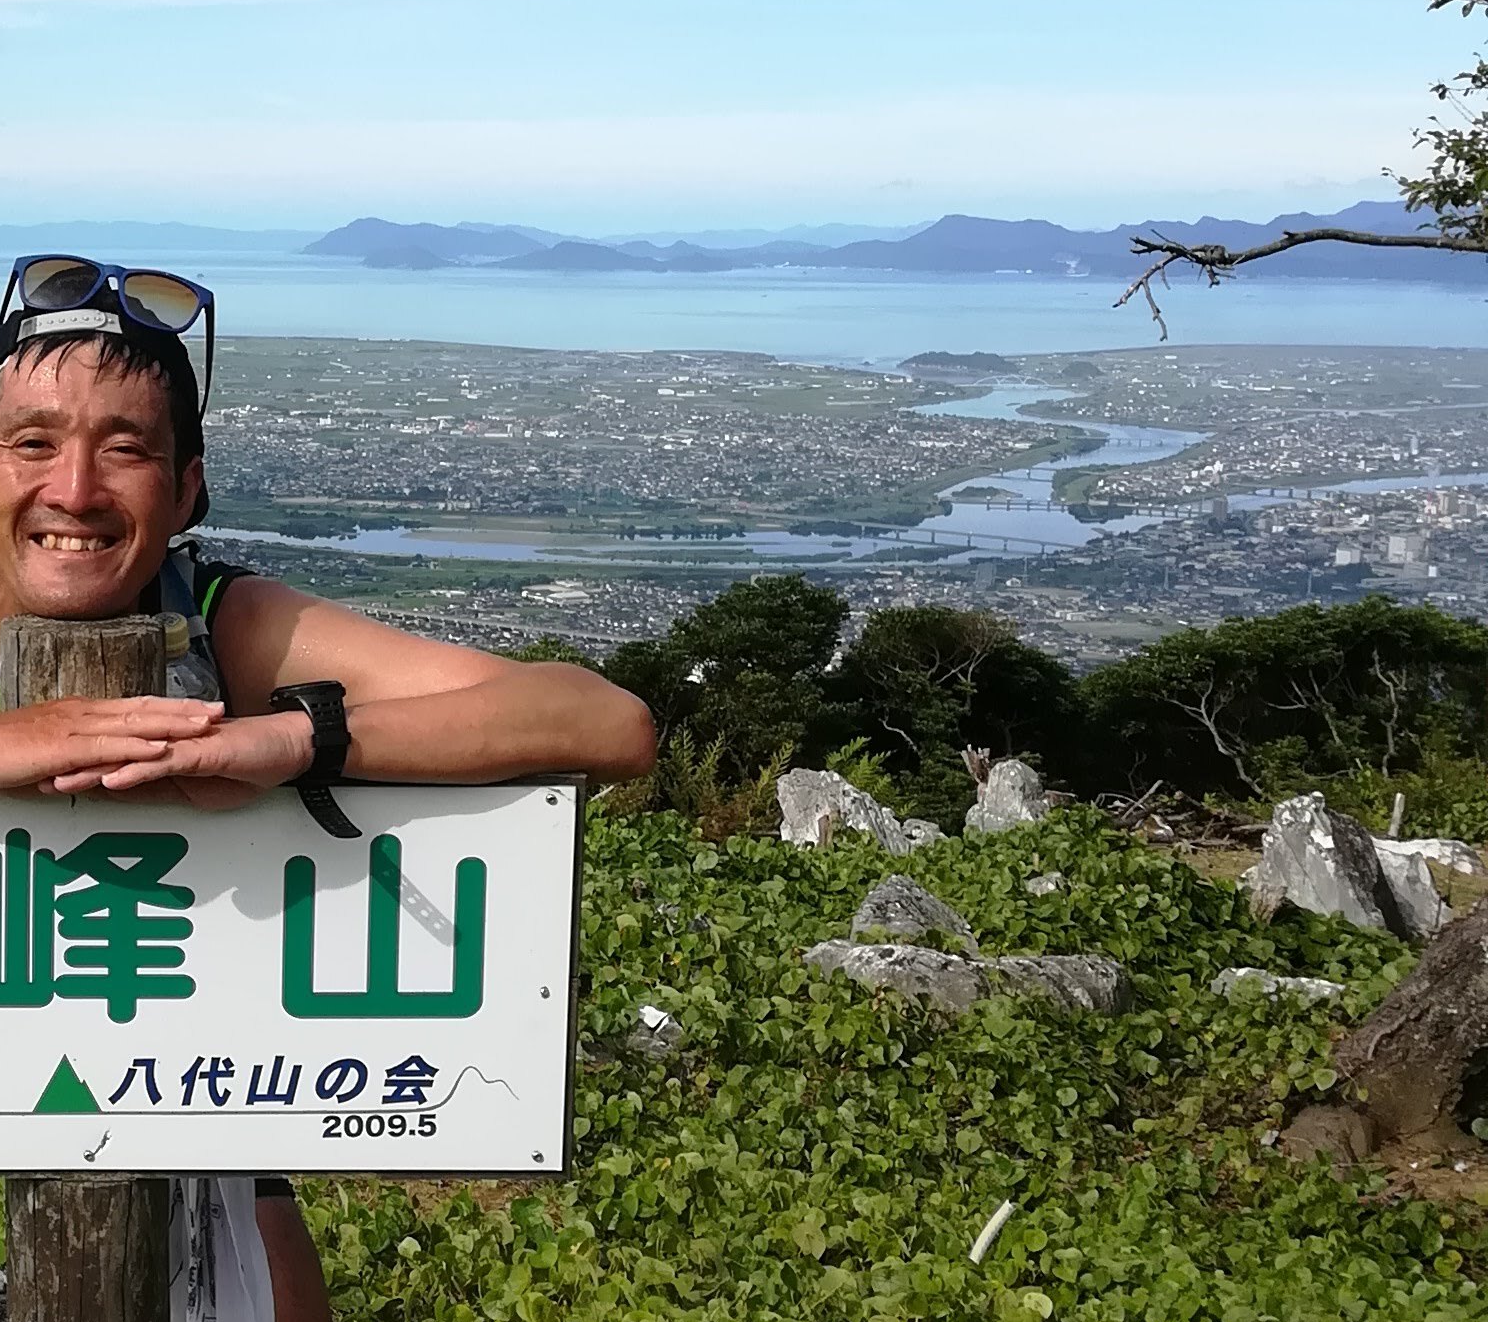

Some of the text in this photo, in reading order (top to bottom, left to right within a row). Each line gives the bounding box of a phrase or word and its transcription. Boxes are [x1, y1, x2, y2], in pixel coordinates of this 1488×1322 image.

[108, 1054, 441, 1108] 八代山の会
[322, 1113, 438, 1139] 2009.5
